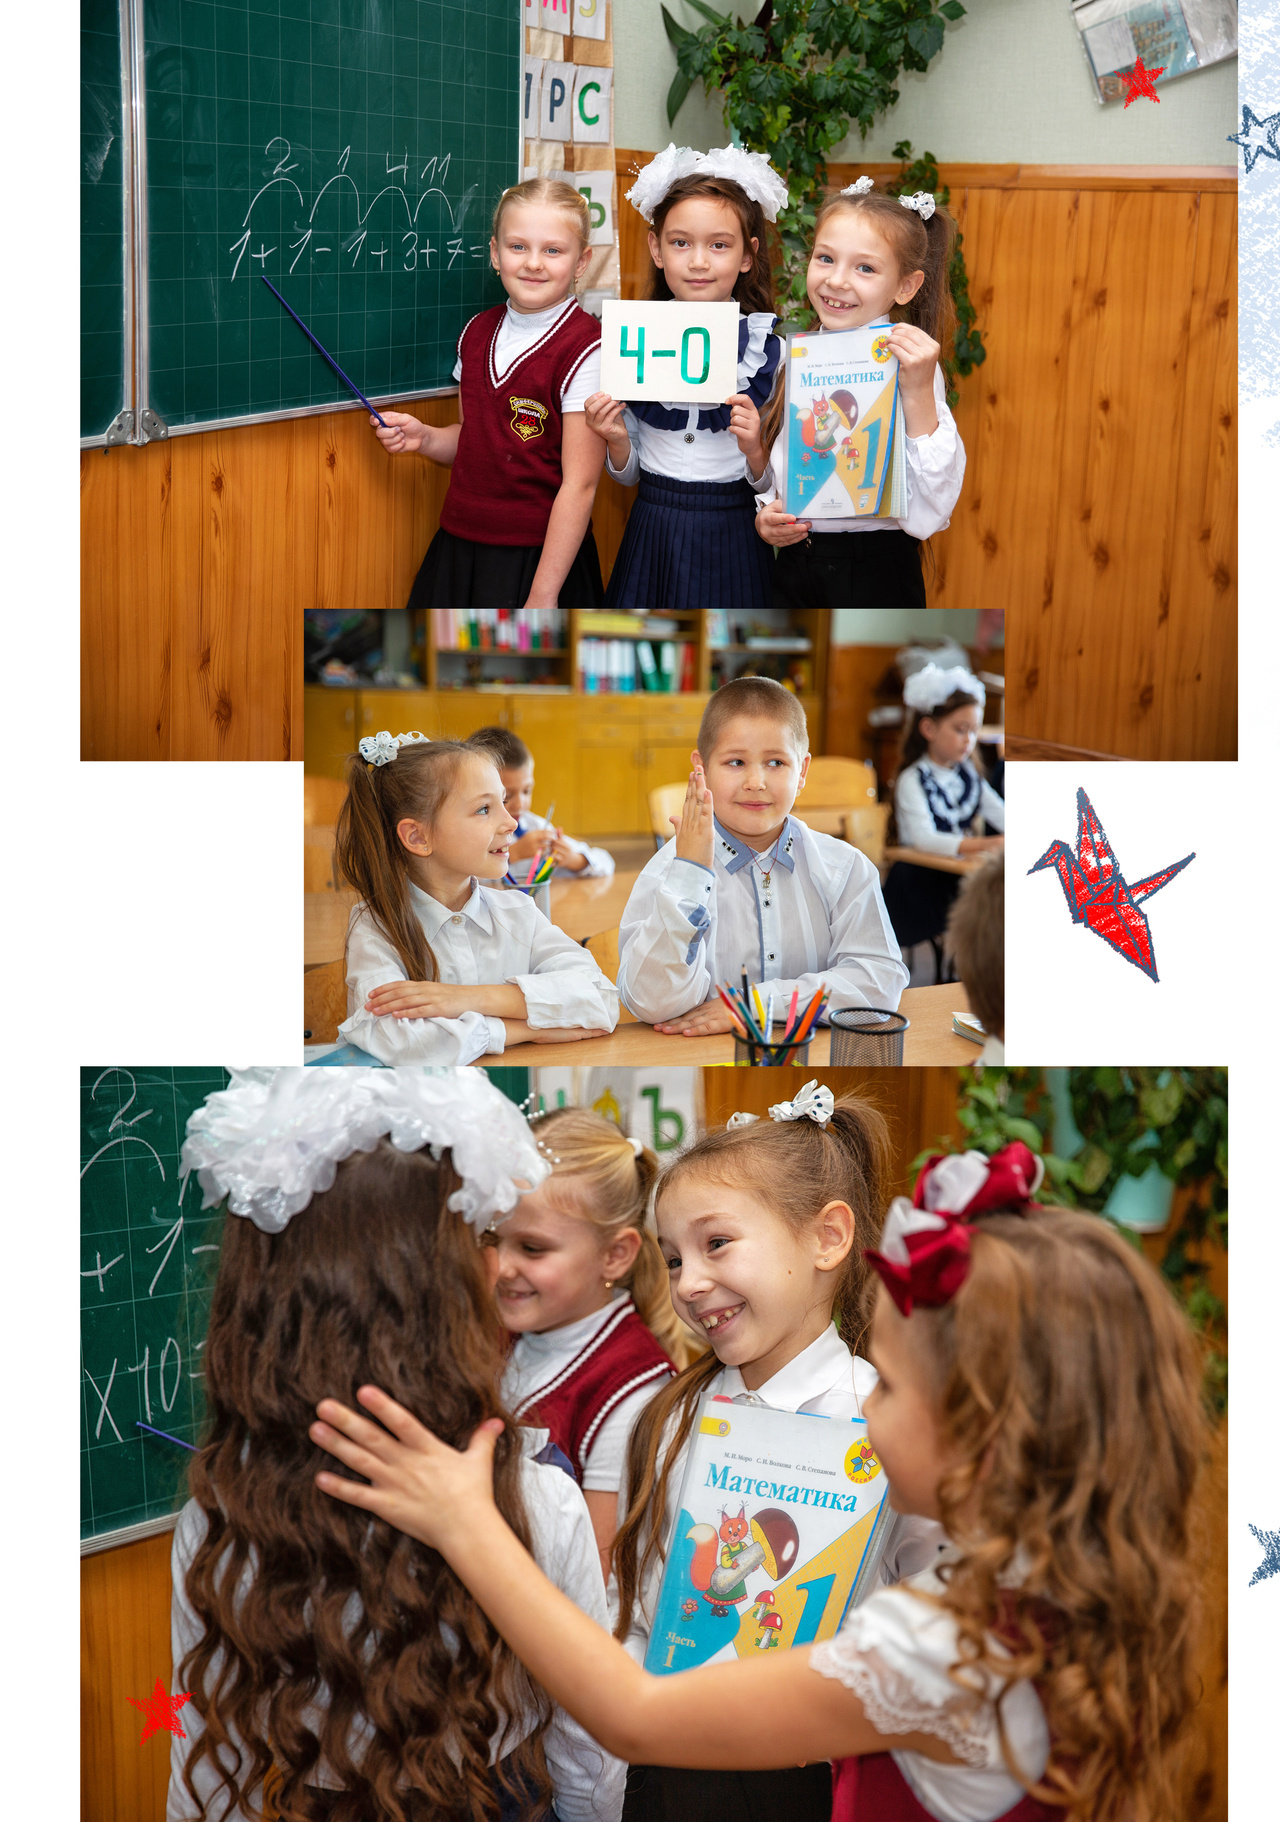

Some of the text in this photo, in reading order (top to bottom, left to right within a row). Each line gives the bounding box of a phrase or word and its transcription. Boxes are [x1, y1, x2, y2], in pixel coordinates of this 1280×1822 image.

[265, 136, 299, 175] 2
[385, 145, 408, 186] 4
[800, 370, 884, 388] Математика
[520, 414, 536, 426] 28
[857, 417, 882, 490] 1
[798, 481, 804, 495] 1
[92, 1067, 153, 1133] 2
[703, 1462, 858, 1513] Математика
[665, 1631, 696, 1648] Часть
[662, 1644, 676, 1669] 1
